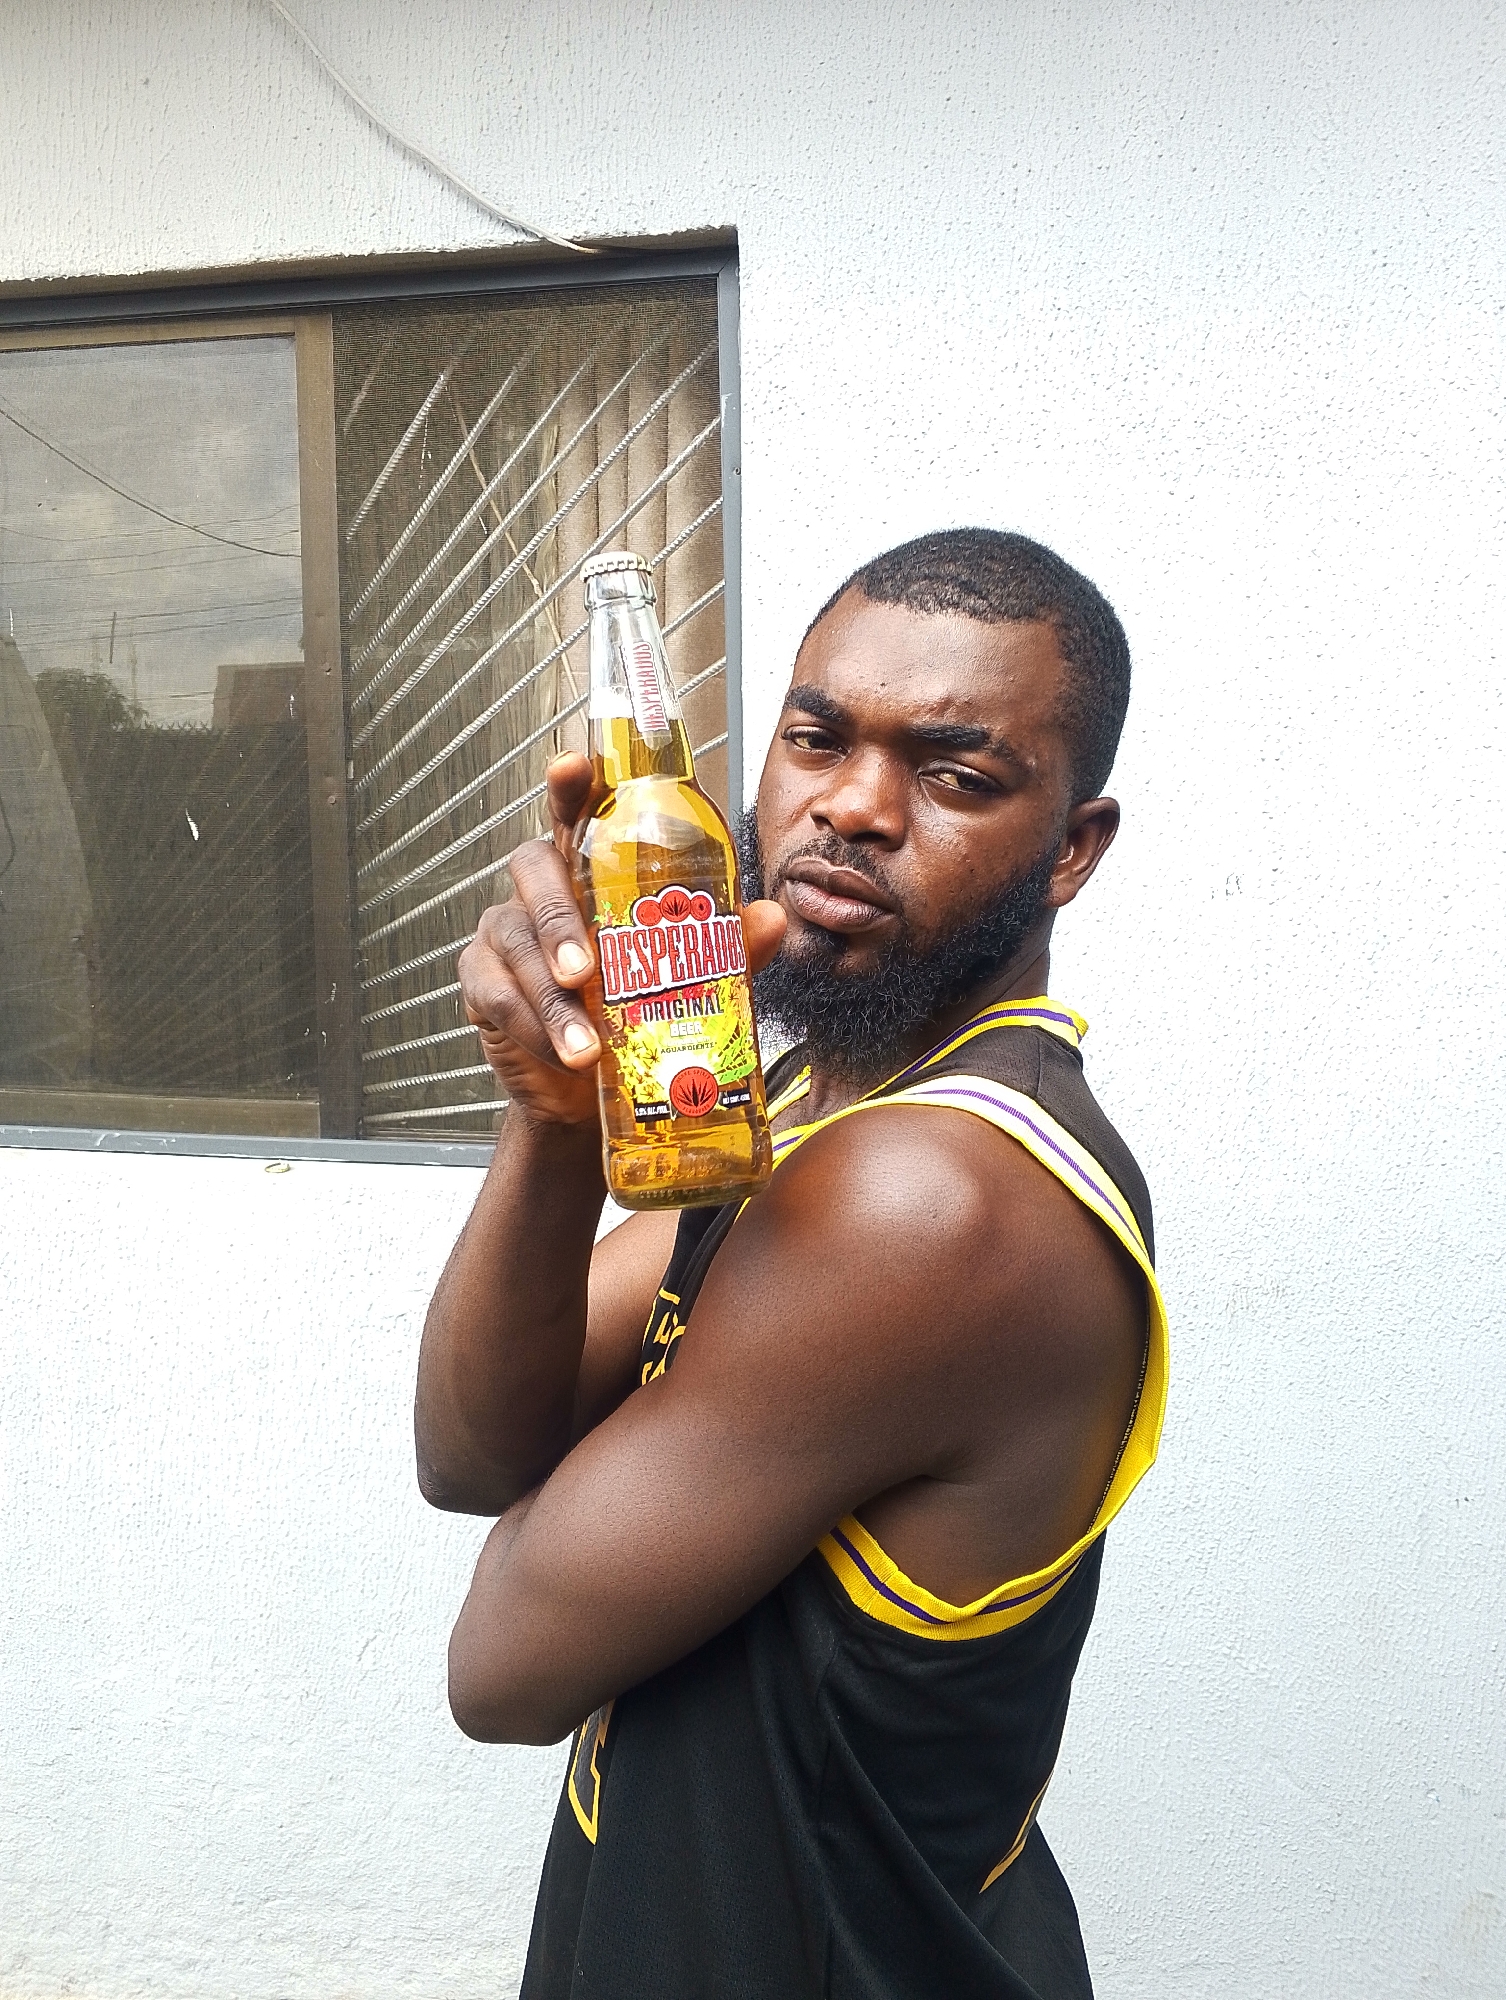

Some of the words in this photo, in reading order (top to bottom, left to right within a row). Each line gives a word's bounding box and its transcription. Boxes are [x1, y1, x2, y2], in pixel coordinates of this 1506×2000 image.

[632, 643, 667, 729] DESPERADOS
[601, 920, 746, 996] DESPERADOS
[642, 993, 725, 1022] ORIGINAL
[669, 1021, 702, 1038] BEER
